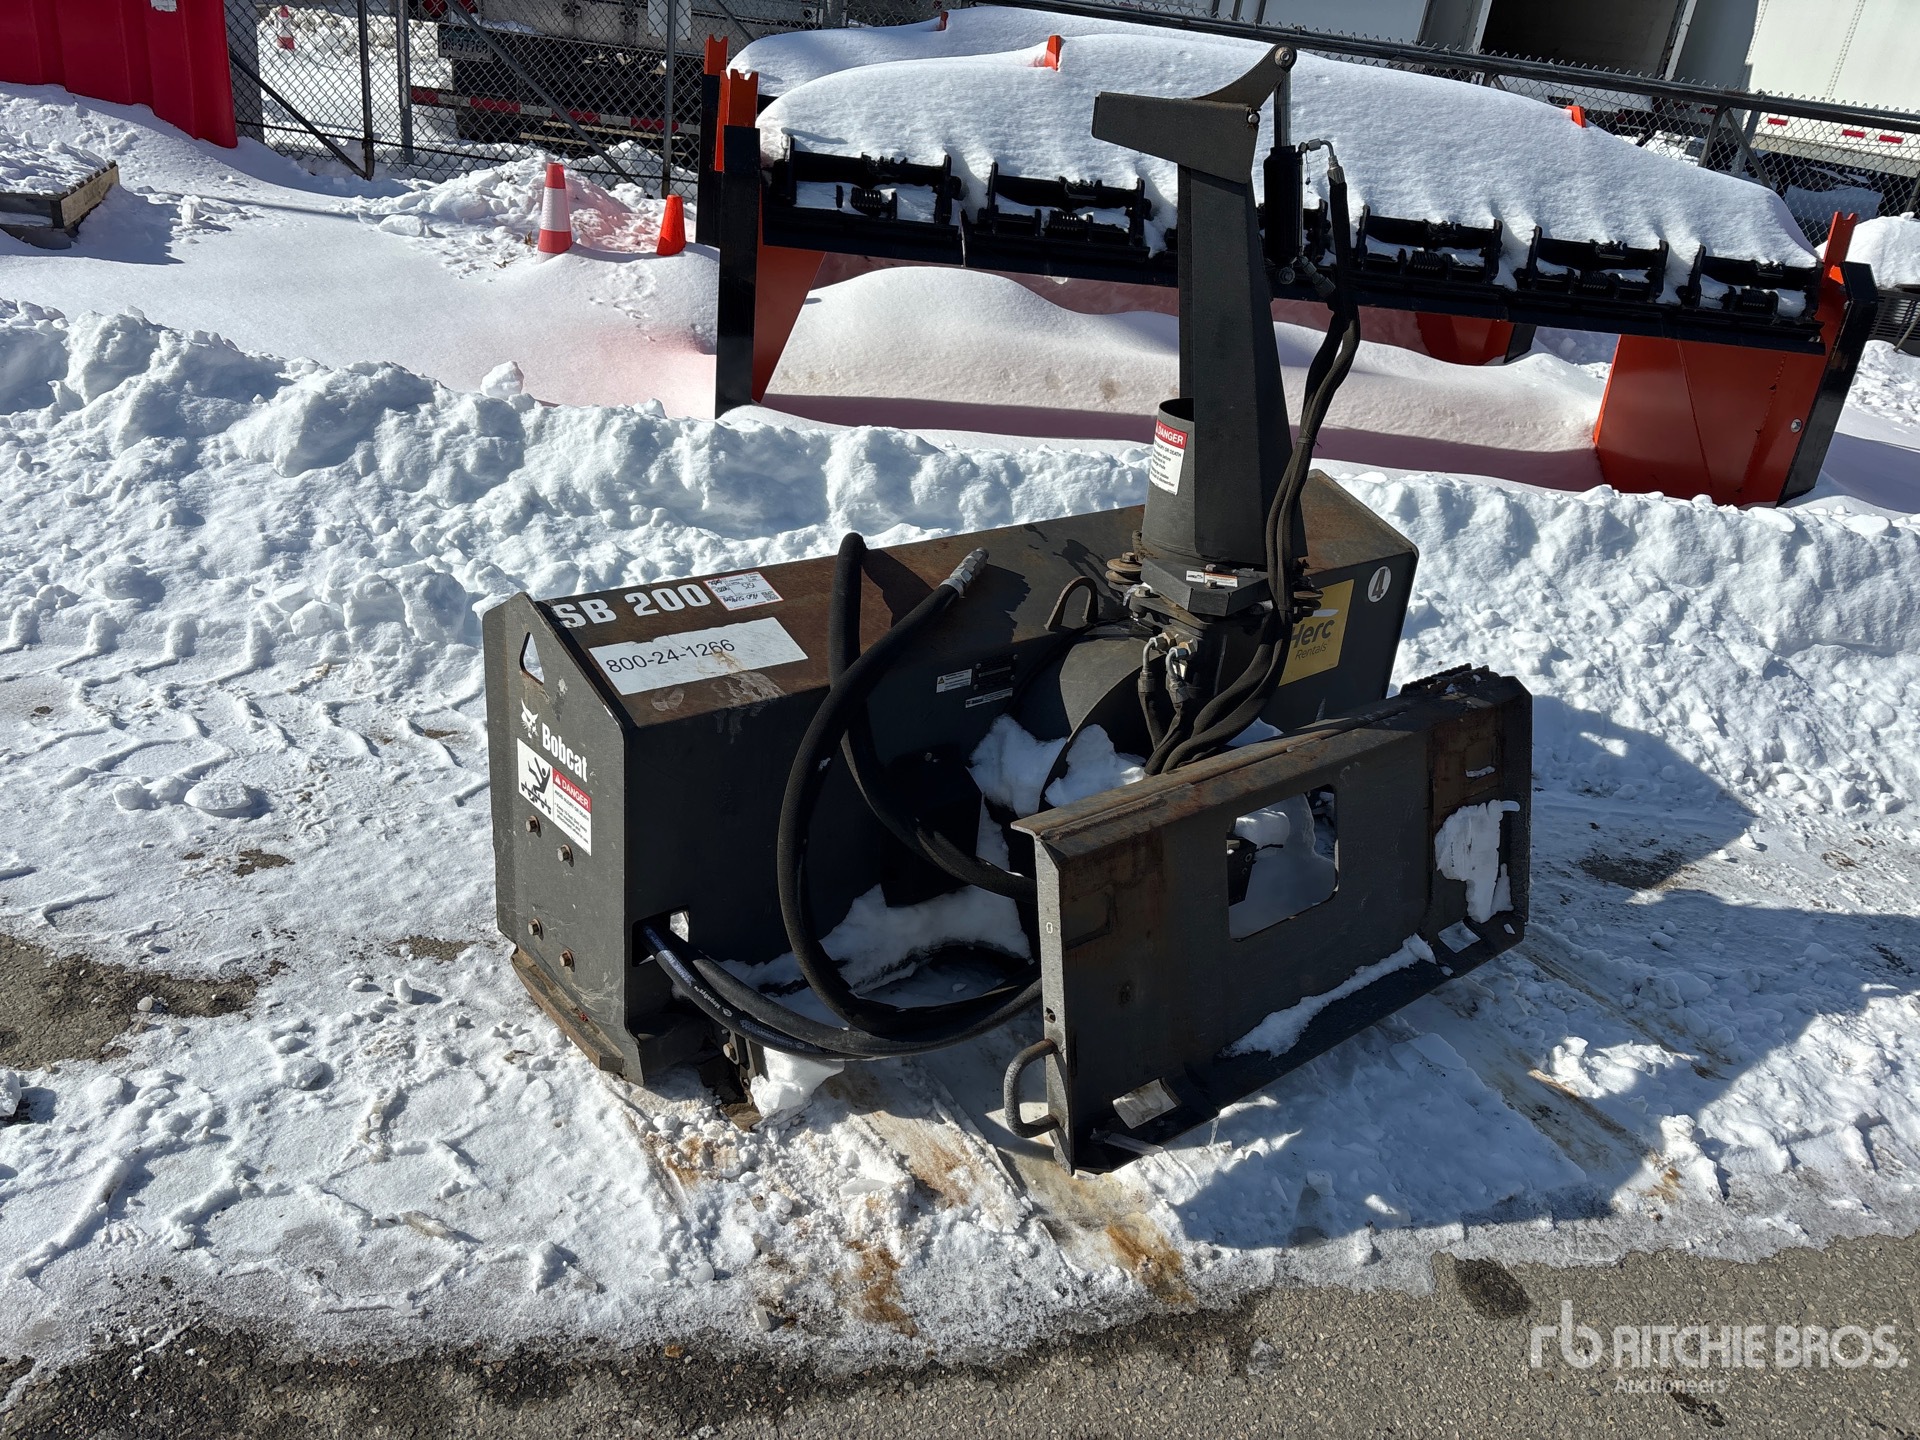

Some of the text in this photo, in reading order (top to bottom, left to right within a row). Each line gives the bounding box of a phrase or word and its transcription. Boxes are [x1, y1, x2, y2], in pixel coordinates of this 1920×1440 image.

[1158, 426, 1184, 445] DANGER
[1372, 569, 1385, 599] 4
[553, 584, 711, 628] SB 200
[1289, 619, 1335, 649] Herc
[606, 639, 736, 673] 800-24-1266
[1294, 642, 1328, 660] Rentals
[542, 723, 588, 783] Bobcat
[561, 779, 589, 809] DANGER
